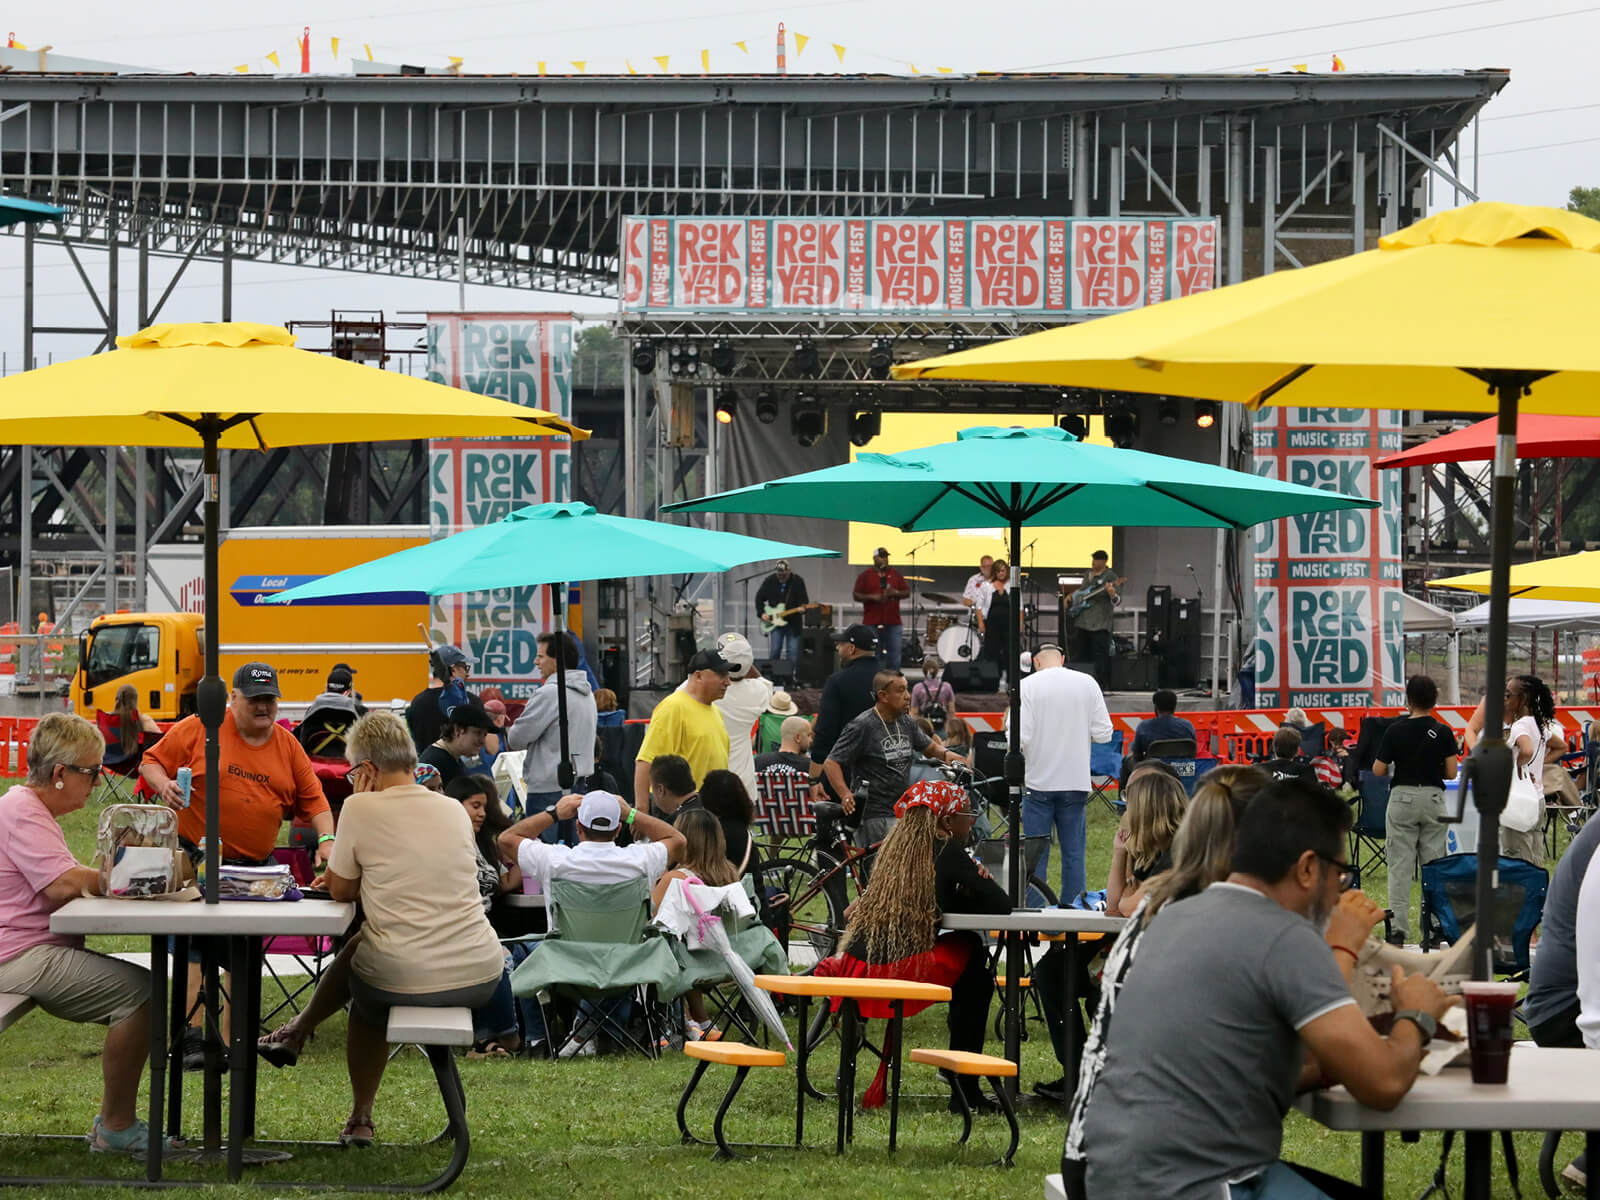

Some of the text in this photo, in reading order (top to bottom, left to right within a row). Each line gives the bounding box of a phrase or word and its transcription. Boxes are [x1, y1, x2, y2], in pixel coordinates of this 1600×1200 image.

[653, 225, 667, 253] FEST
[751, 225, 765, 253] FEST
[850, 225, 864, 254] FEST
[950, 226, 964, 254] FEST
[1050, 225, 1064, 254] FEST
[1150, 226, 1164, 254] FEST
[1339, 433, 1366, 446] FEST
[466, 453, 537, 502] ROCK
[261, 577, 288, 587] Local
[1341, 563, 1367, 577] FEST
[1292, 590, 1366, 641] ROCK
[1292, 638, 1368, 684] YARD
[1342, 693, 1369, 707] FEST
[228, 764, 270, 784] EQUINOX
